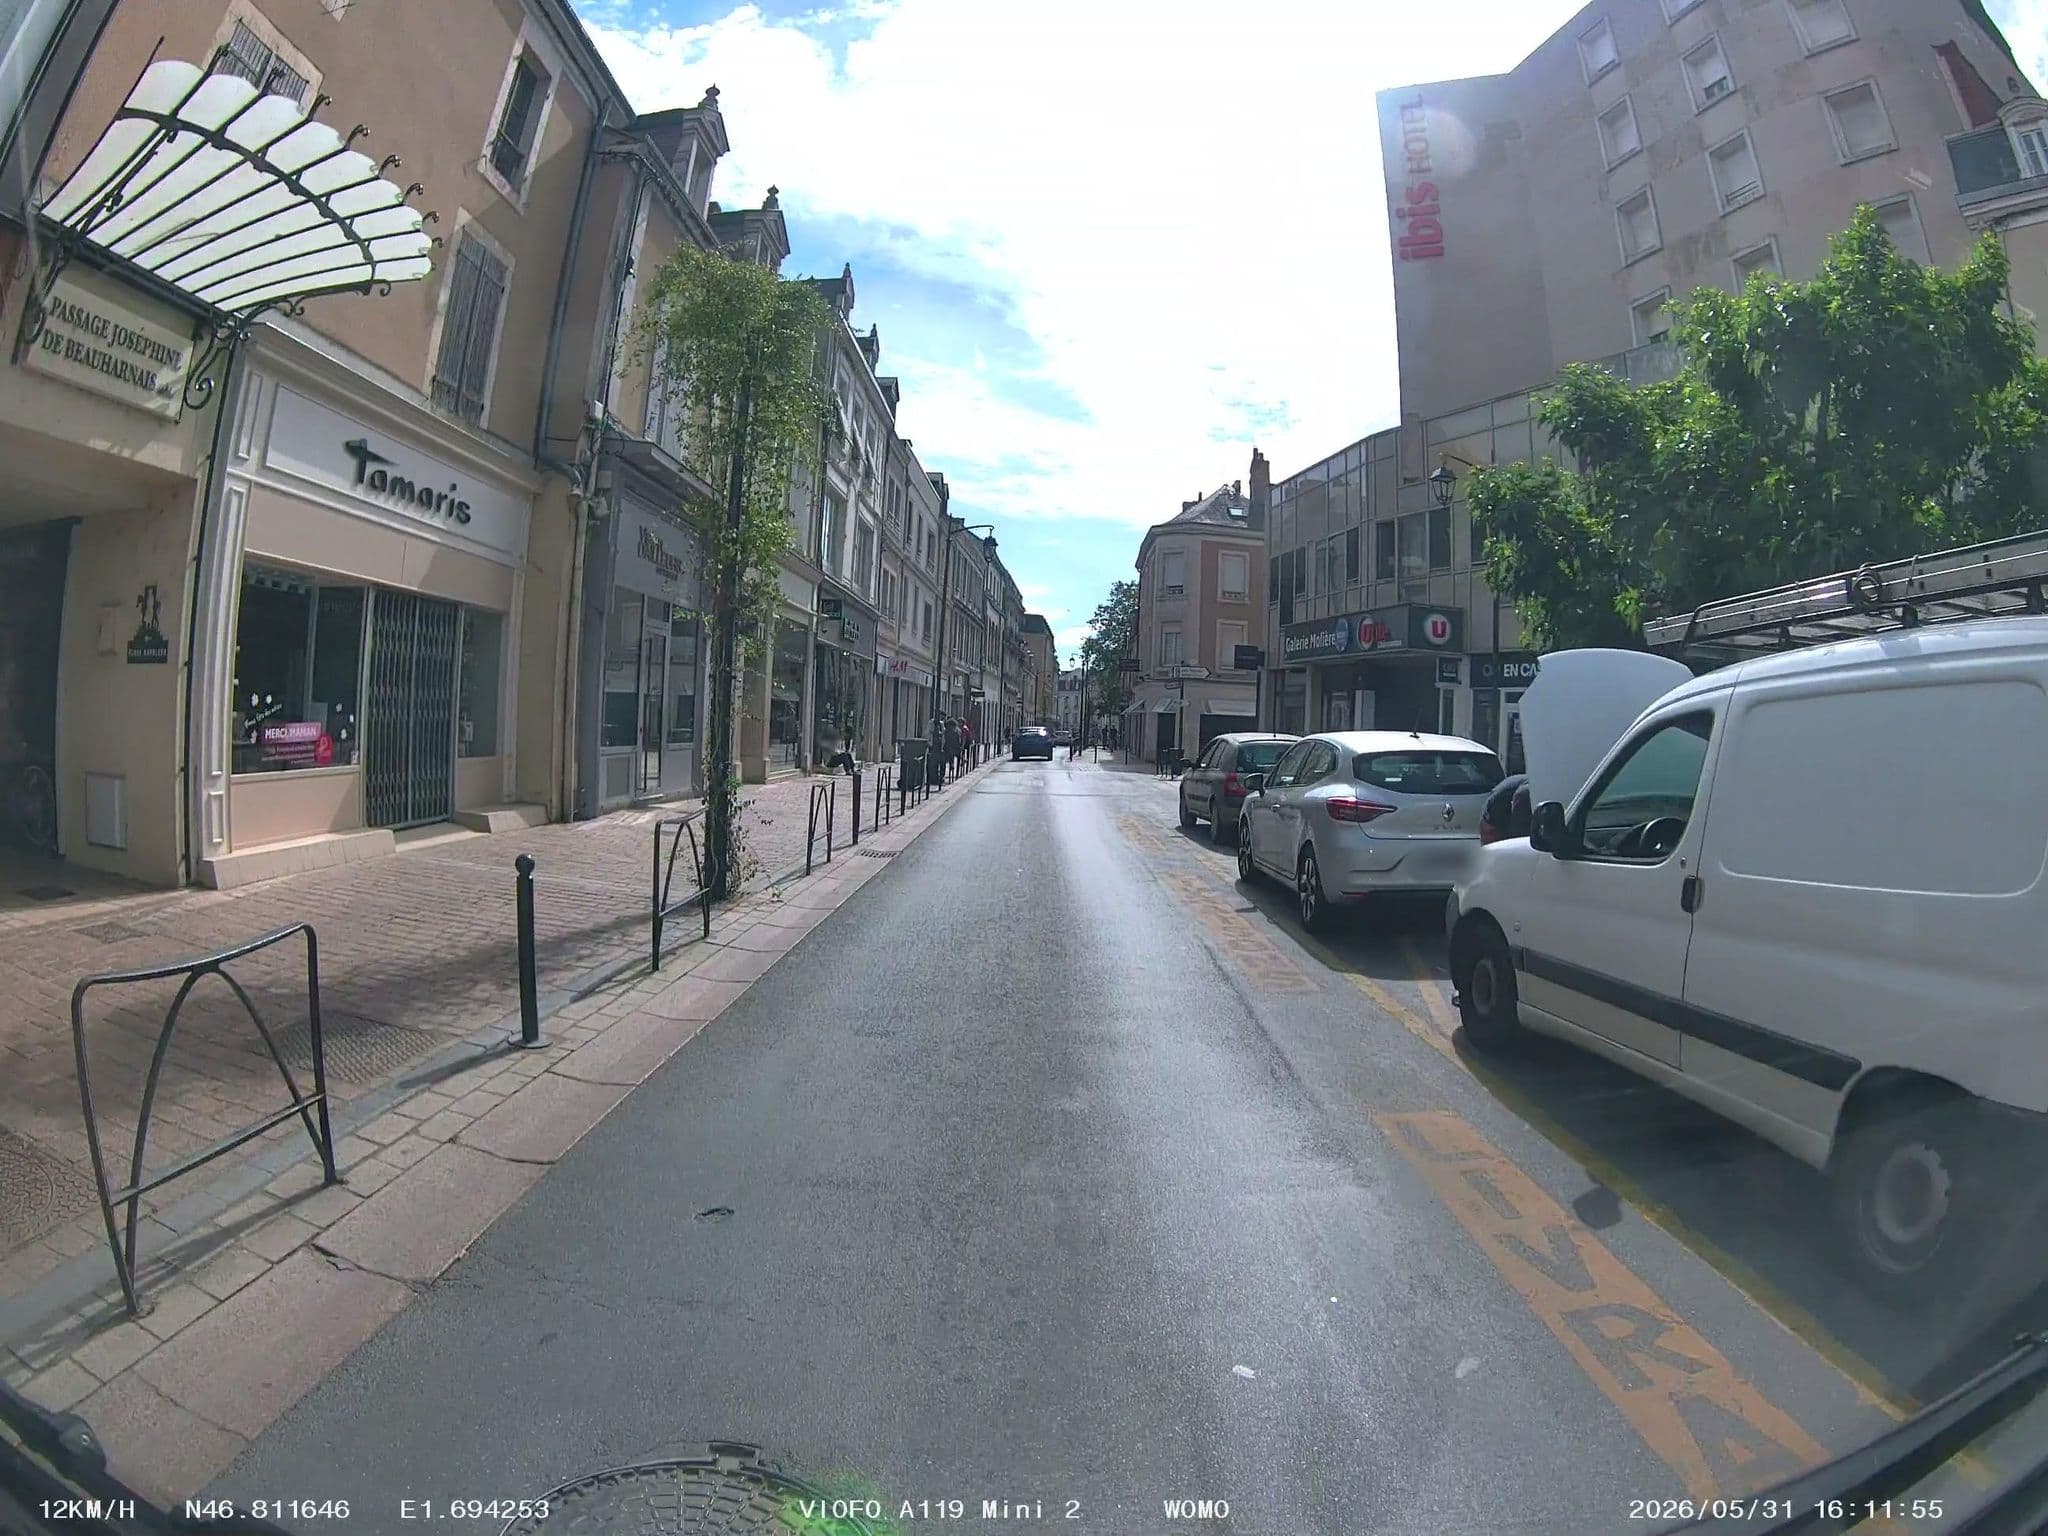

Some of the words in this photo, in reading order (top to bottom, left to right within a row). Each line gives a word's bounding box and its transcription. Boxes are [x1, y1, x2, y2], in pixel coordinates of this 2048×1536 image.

[1396, 181, 1445, 262] ibis
[41, 328, 65, 355] DE
[64, 338, 158, 392] BEAUHARNAIS
[49, 296, 111, 339] PASSAGE
[108, 324, 184, 372] JOSÉPHINE
[344, 438, 472, 526] Tamaris
[1285, 635, 1309, 652] Galerie
[1431, 620, 1448, 639] U
[1503, 663, 1519, 677] EN
